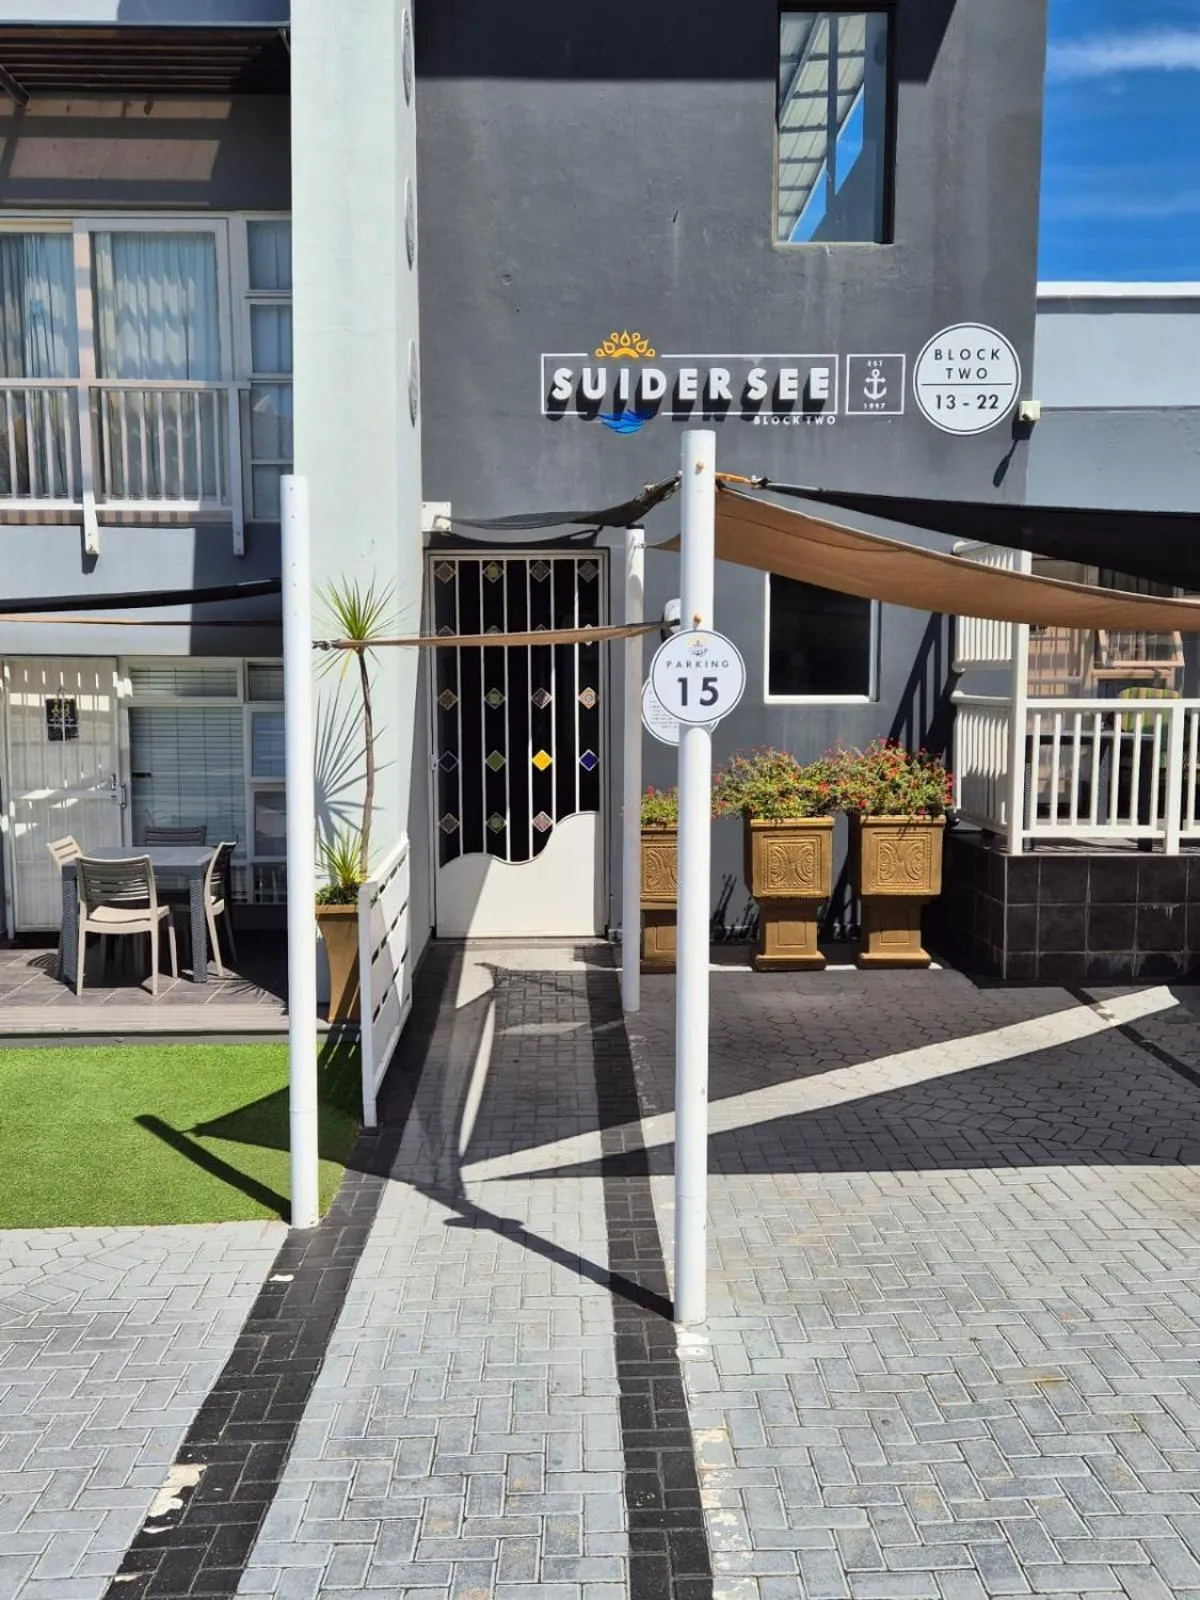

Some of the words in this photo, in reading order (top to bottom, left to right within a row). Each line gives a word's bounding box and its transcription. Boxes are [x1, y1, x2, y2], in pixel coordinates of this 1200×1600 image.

[934, 348, 1001, 361] BLOCK
[945, 367, 988, 380] TWO
[551, 367, 830, 400] SUIDERSEE
[753, 415, 801, 425] BLOCK
[806, 415, 836, 425] TWO
[666, 660, 730, 669] PARKING
[677, 677, 719, 707] 15
